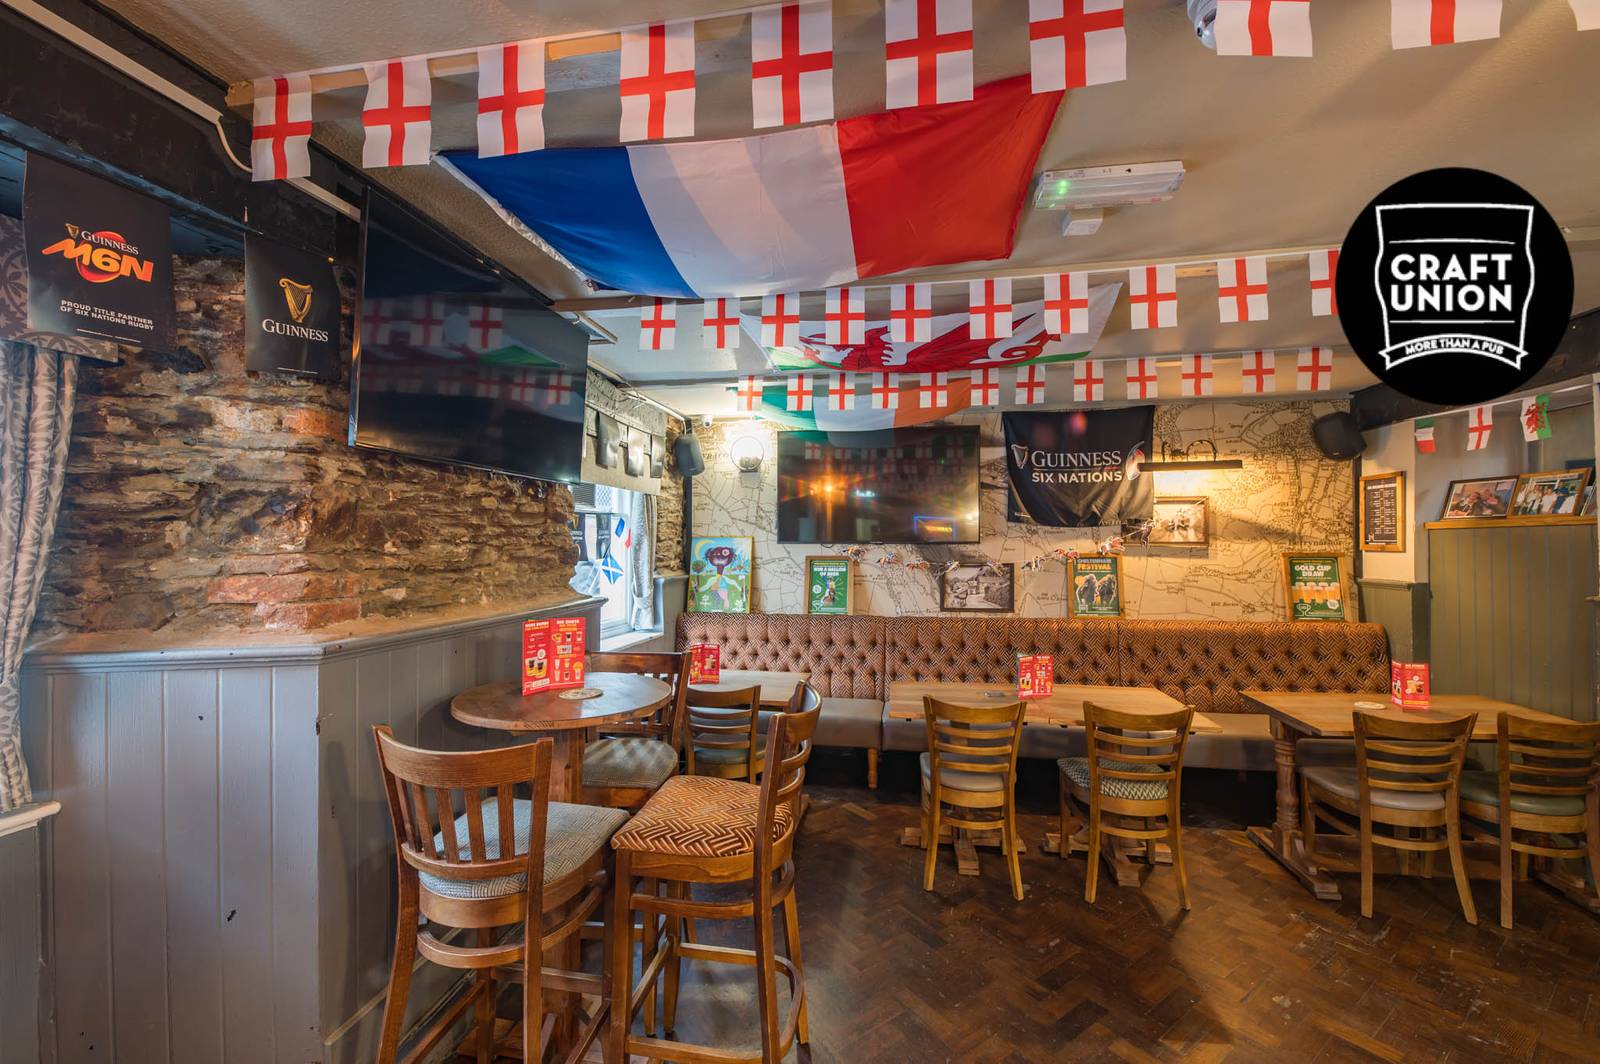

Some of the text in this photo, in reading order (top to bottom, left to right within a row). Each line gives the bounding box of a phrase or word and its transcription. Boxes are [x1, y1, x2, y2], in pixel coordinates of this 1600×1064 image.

[81, 230, 139, 255] GUINNESS
[61, 300, 153, 325] PROUD TITLE PARTNER
[75, 309, 89, 317] SIX
[91, 312, 126, 325] NATIONS
[127, 320, 154, 331] RUGBY
[261, 318, 329, 342] GUINNESS
[1031, 450, 1122, 468] GUINNESS
[1031, 471, 1123, 484] SIX NATIONS
